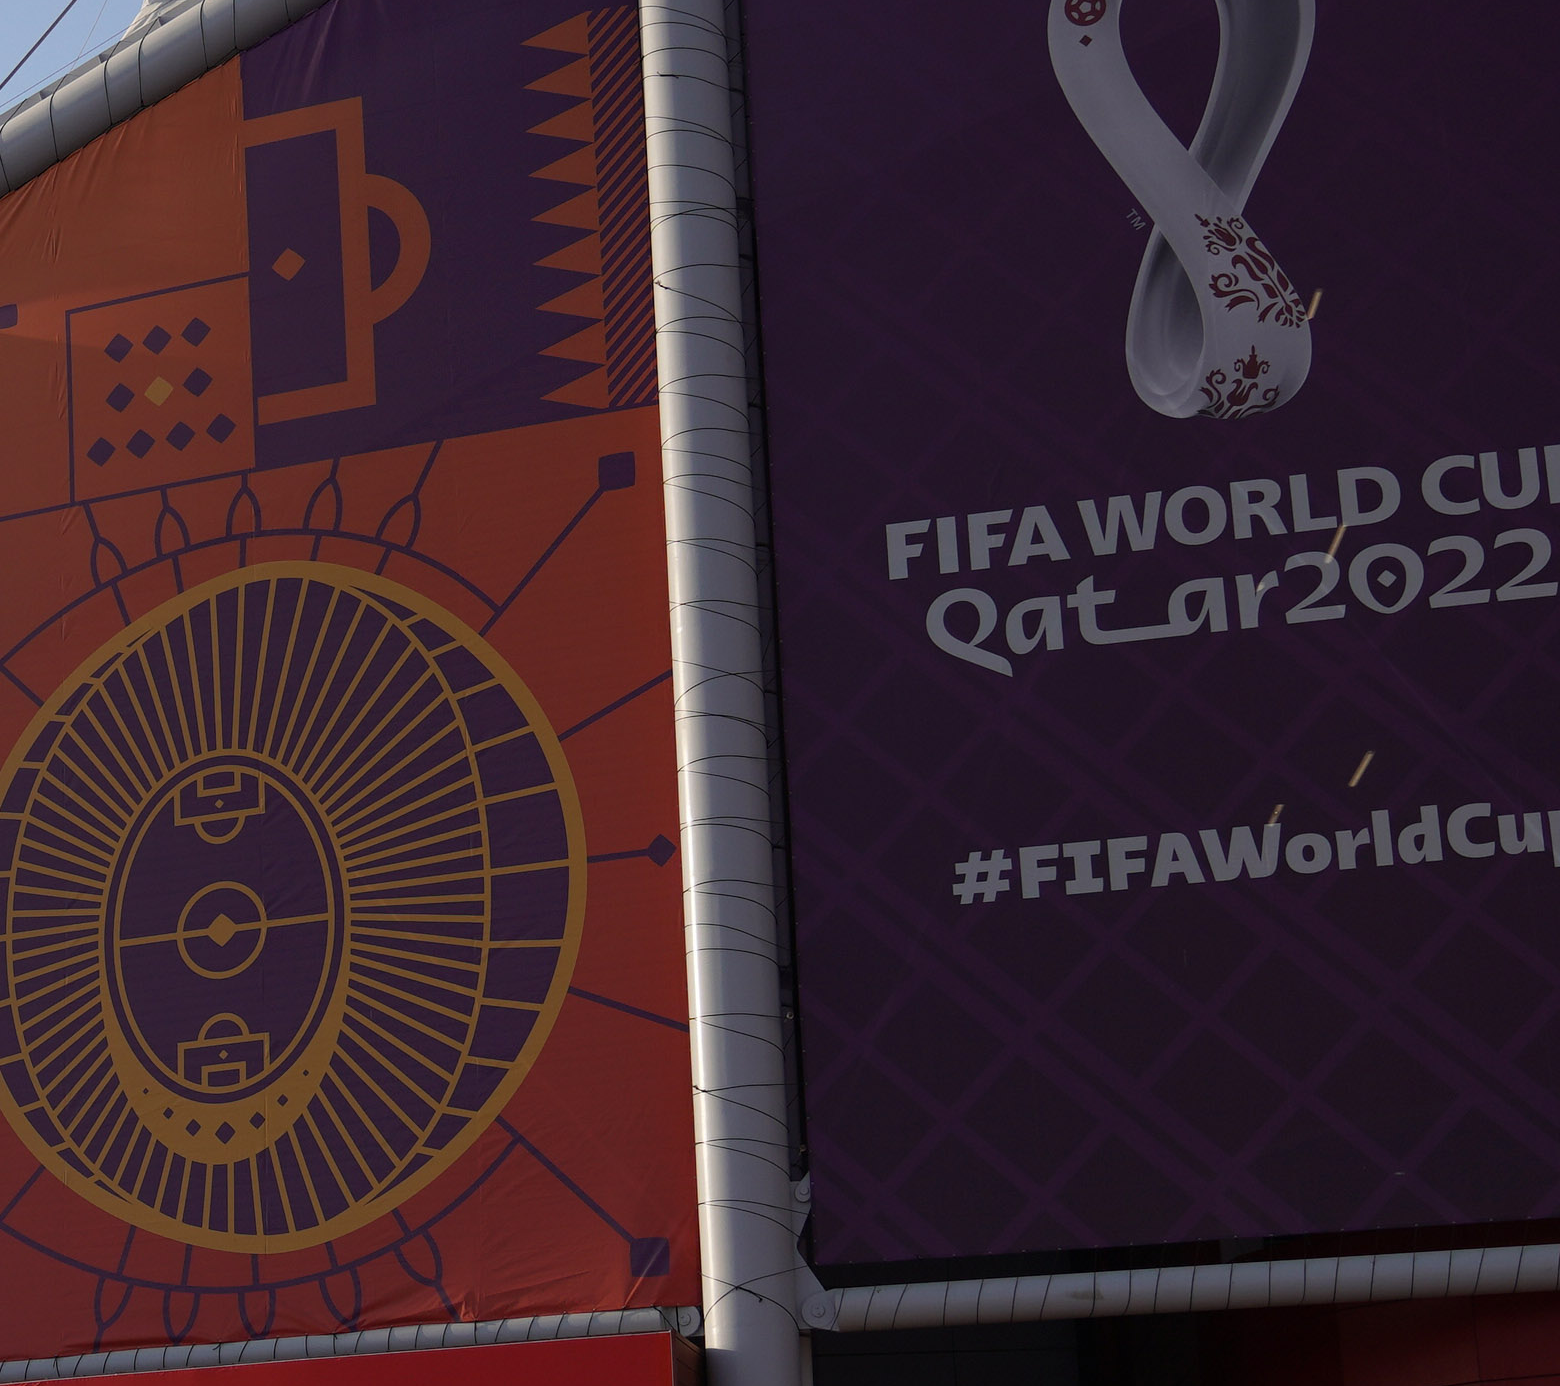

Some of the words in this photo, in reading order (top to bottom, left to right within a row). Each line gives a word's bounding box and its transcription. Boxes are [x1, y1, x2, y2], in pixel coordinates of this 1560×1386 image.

[883, 504, 1066, 581] FIFA
[1080, 464, 1402, 556] WORLD
[925, 527, 1560, 677] Qatar2022
